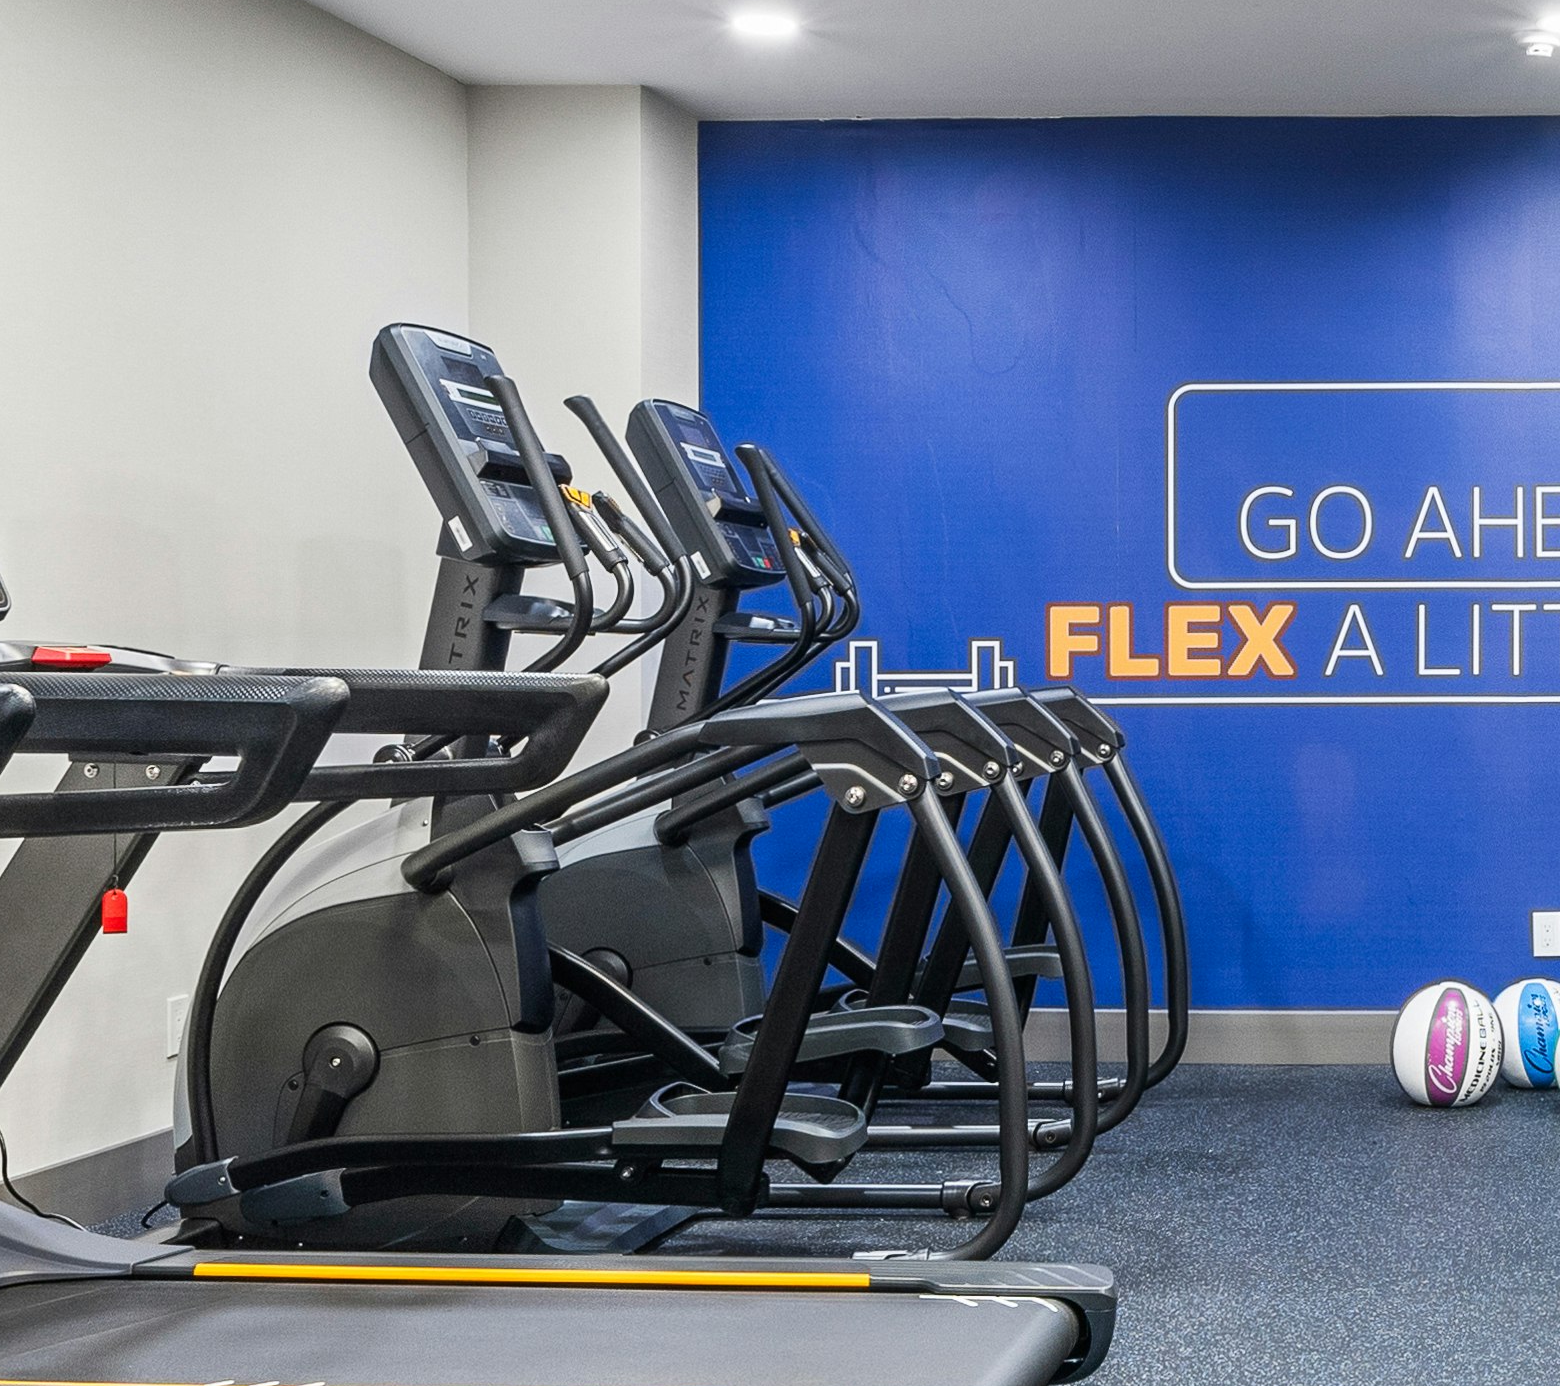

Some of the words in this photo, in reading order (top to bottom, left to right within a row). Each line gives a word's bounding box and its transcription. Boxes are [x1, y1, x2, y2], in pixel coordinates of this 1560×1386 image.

[1240, 485, 1374, 561] GO
[448, 575, 479, 670] TRIX
[676, 596, 710, 711] MATRIX
[1046, 603, 1297, 678] FLEX
[1324, 603, 1385, 677] A
[1428, 1000, 1461, 1093] Champion
[1459, 1041, 1486, 1103] MEDICINE
[1473, 999, 1486, 1039] BALL
